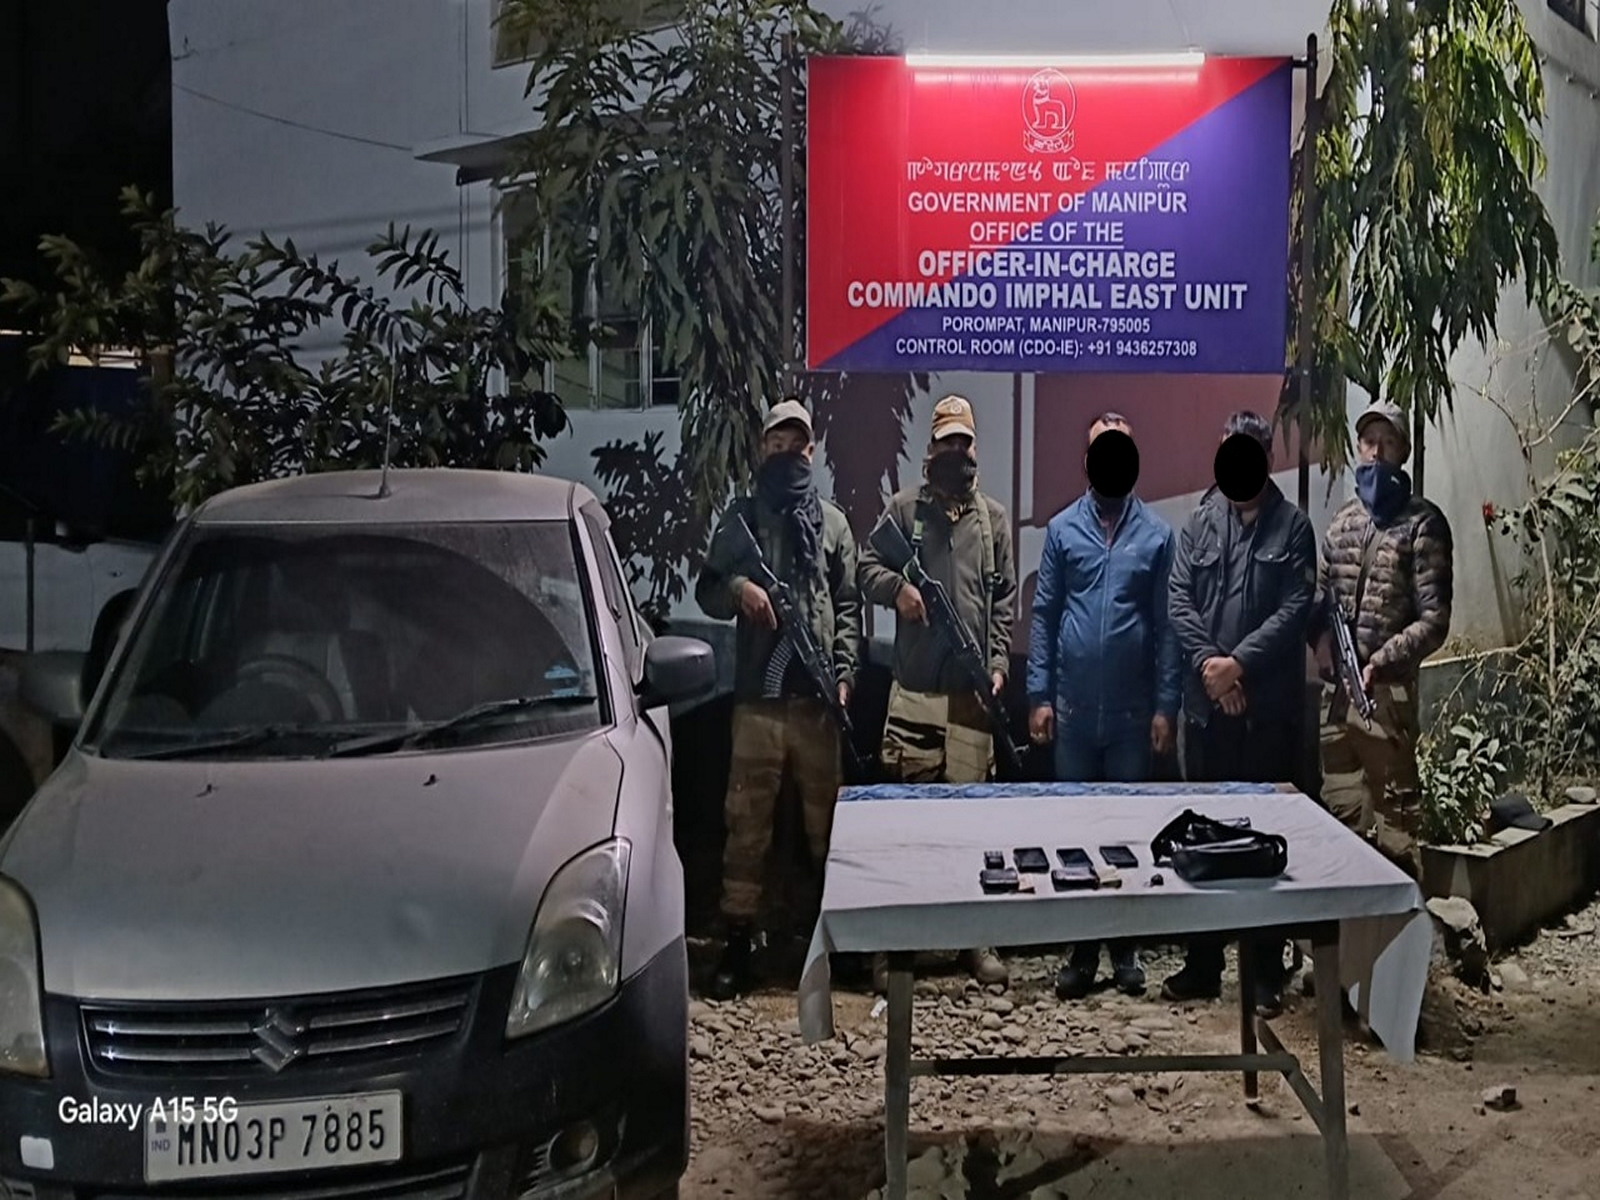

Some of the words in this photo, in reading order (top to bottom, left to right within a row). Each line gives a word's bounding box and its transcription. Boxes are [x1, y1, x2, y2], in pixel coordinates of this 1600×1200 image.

[908, 192, 1052, 213] GOVERNMENT
[1058, 192, 1086, 213] OF
[1091, 191, 1188, 213] MANIPUR
[969, 221, 1043, 242] OFFICE
[1050, 221, 1078, 242] OF
[1084, 221, 1124, 242] THE
[918, 250, 1176, 278] OFFICER-IN-CHARGE
[847, 281, 997, 308] COMMANDO
[1005, 283, 1102, 309] IMPHAL
[1110, 284, 1177, 310] EAST
[1184, 284, 1248, 310] UNIT
[942, 316, 1026, 334] POROMPAT,
[1029, 317, 1151, 334] MANIPUR-795005
[895, 338, 967, 355] CONTROL
[970, 338, 1015, 355] ROOM
[1018, 338, 1084, 358] (CDO-IE):
[1087, 340, 1113, 356] +91
[1116, 340, 1197, 357] 9436257308
[151, 1140, 171, 1152] IND
[177, 1116, 285, 1166] MN03P
[301, 1109, 385, 1157] 7885
